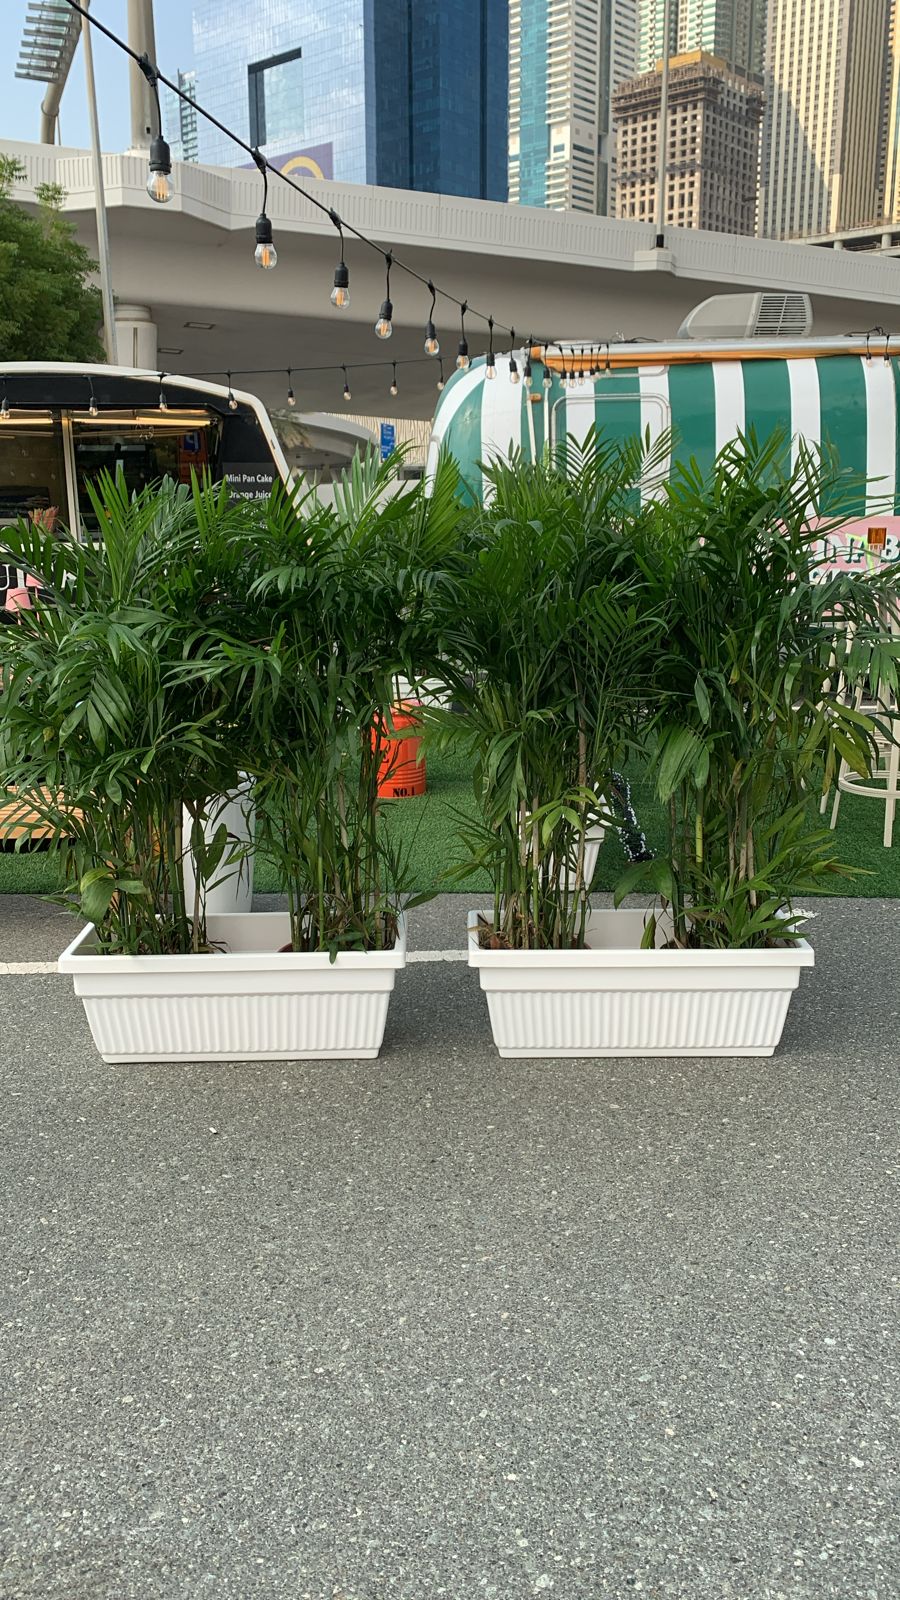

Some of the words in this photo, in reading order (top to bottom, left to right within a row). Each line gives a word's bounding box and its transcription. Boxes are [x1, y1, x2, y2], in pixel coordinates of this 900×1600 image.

[226, 473, 241, 483] Mini
[242, 474, 256, 483] Pan
[256, 473, 273, 483] Cake
